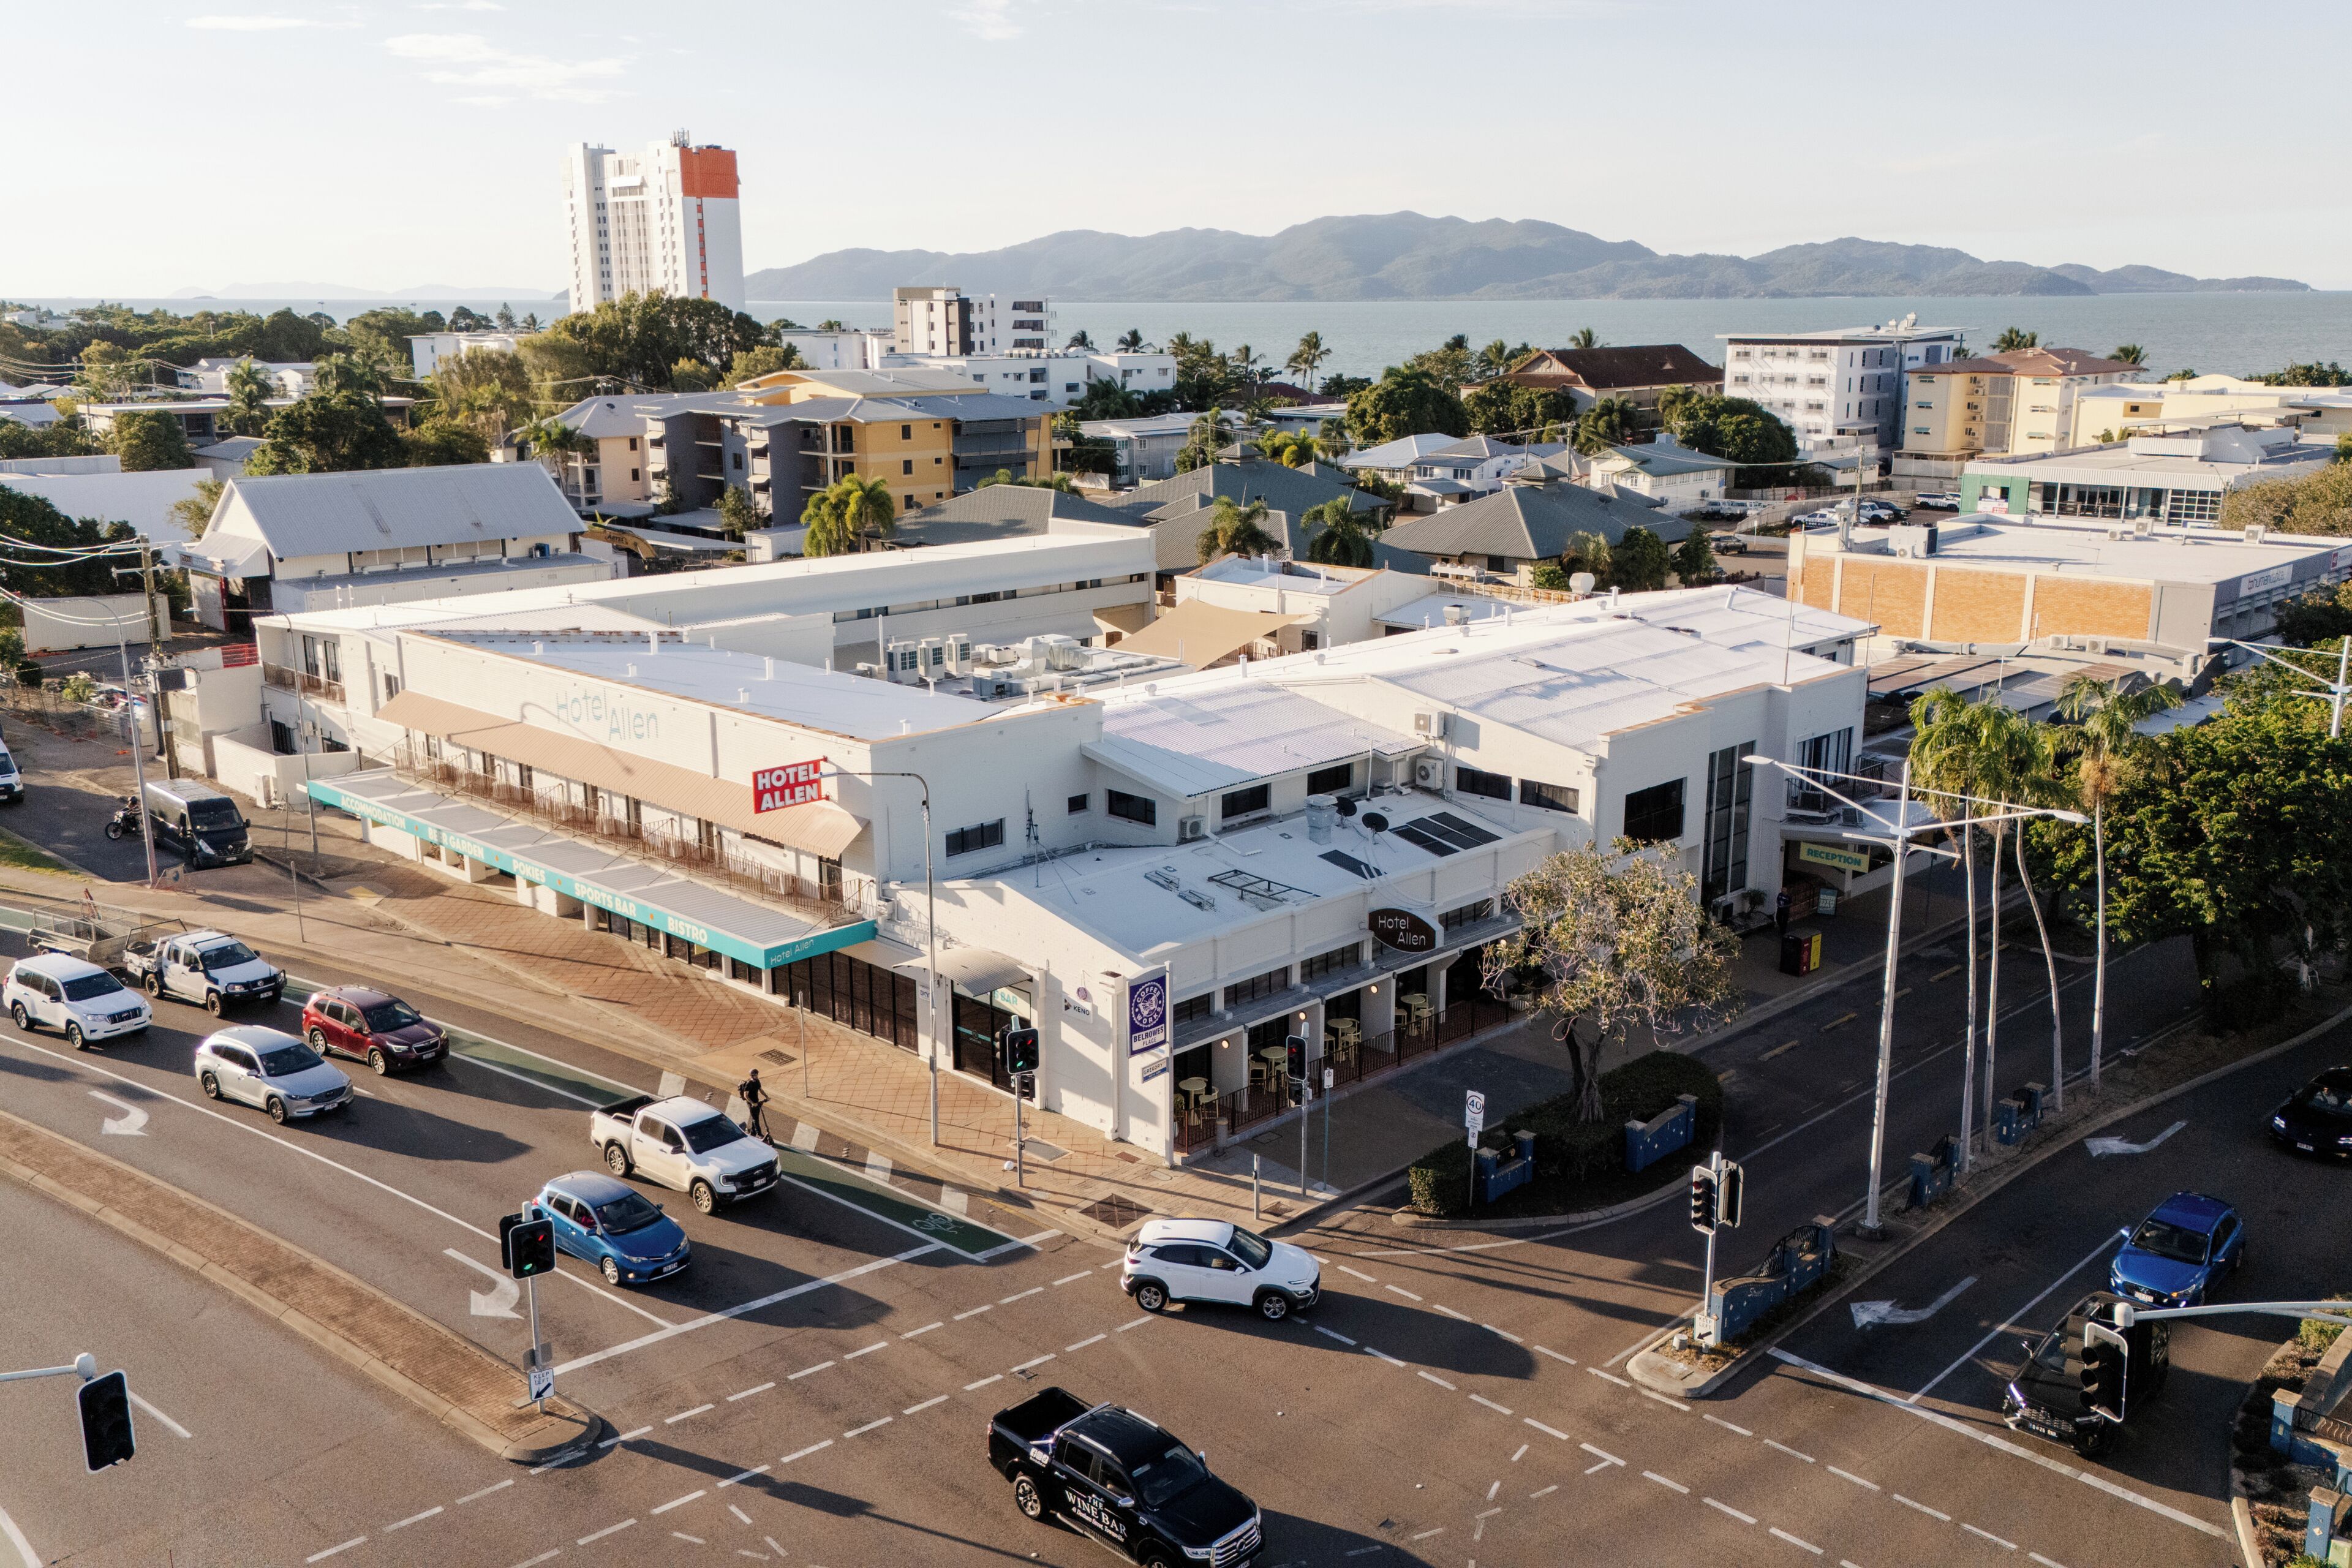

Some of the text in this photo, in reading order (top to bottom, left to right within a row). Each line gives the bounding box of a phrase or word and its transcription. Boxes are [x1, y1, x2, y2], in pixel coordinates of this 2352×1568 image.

[556, 687, 608, 723] Hotel
[609, 707, 658, 741] Allen
[757, 763, 820, 790] HOTEL
[760, 783, 818, 811] ALLEN
[341, 795, 405, 829] ACCOMMODATION
[449, 835, 484, 860] GARDEN
[1807, 848, 1861, 867] RECEPTION
[512, 859, 545, 883] POKIES
[574, 882, 636, 918] SPORTS BAR
[667, 916, 707, 944] BISTRO
[1378, 916, 1409, 929] Hotel
[1396, 932, 1426, 946] Allen
[770, 938, 814, 965] Hotel Allen
[1000, 992, 1018, 1005] BAR
[1136, 986, 1160, 1003] COFFEE
[1073, 1005, 1090, 1016] KENO
[1136, 1006, 1161, 1024] WORKS
[1133, 1026, 1164, 1042] BELROWES
[1142, 1038, 1156, 1046] PLACE
[1143, 1062, 1163, 1075] GREGORY
[1469, 1099, 1481, 1110] 40
[1087, 1496, 1104, 1510] THE
[1065, 1490, 1128, 1537] WINE BAR
